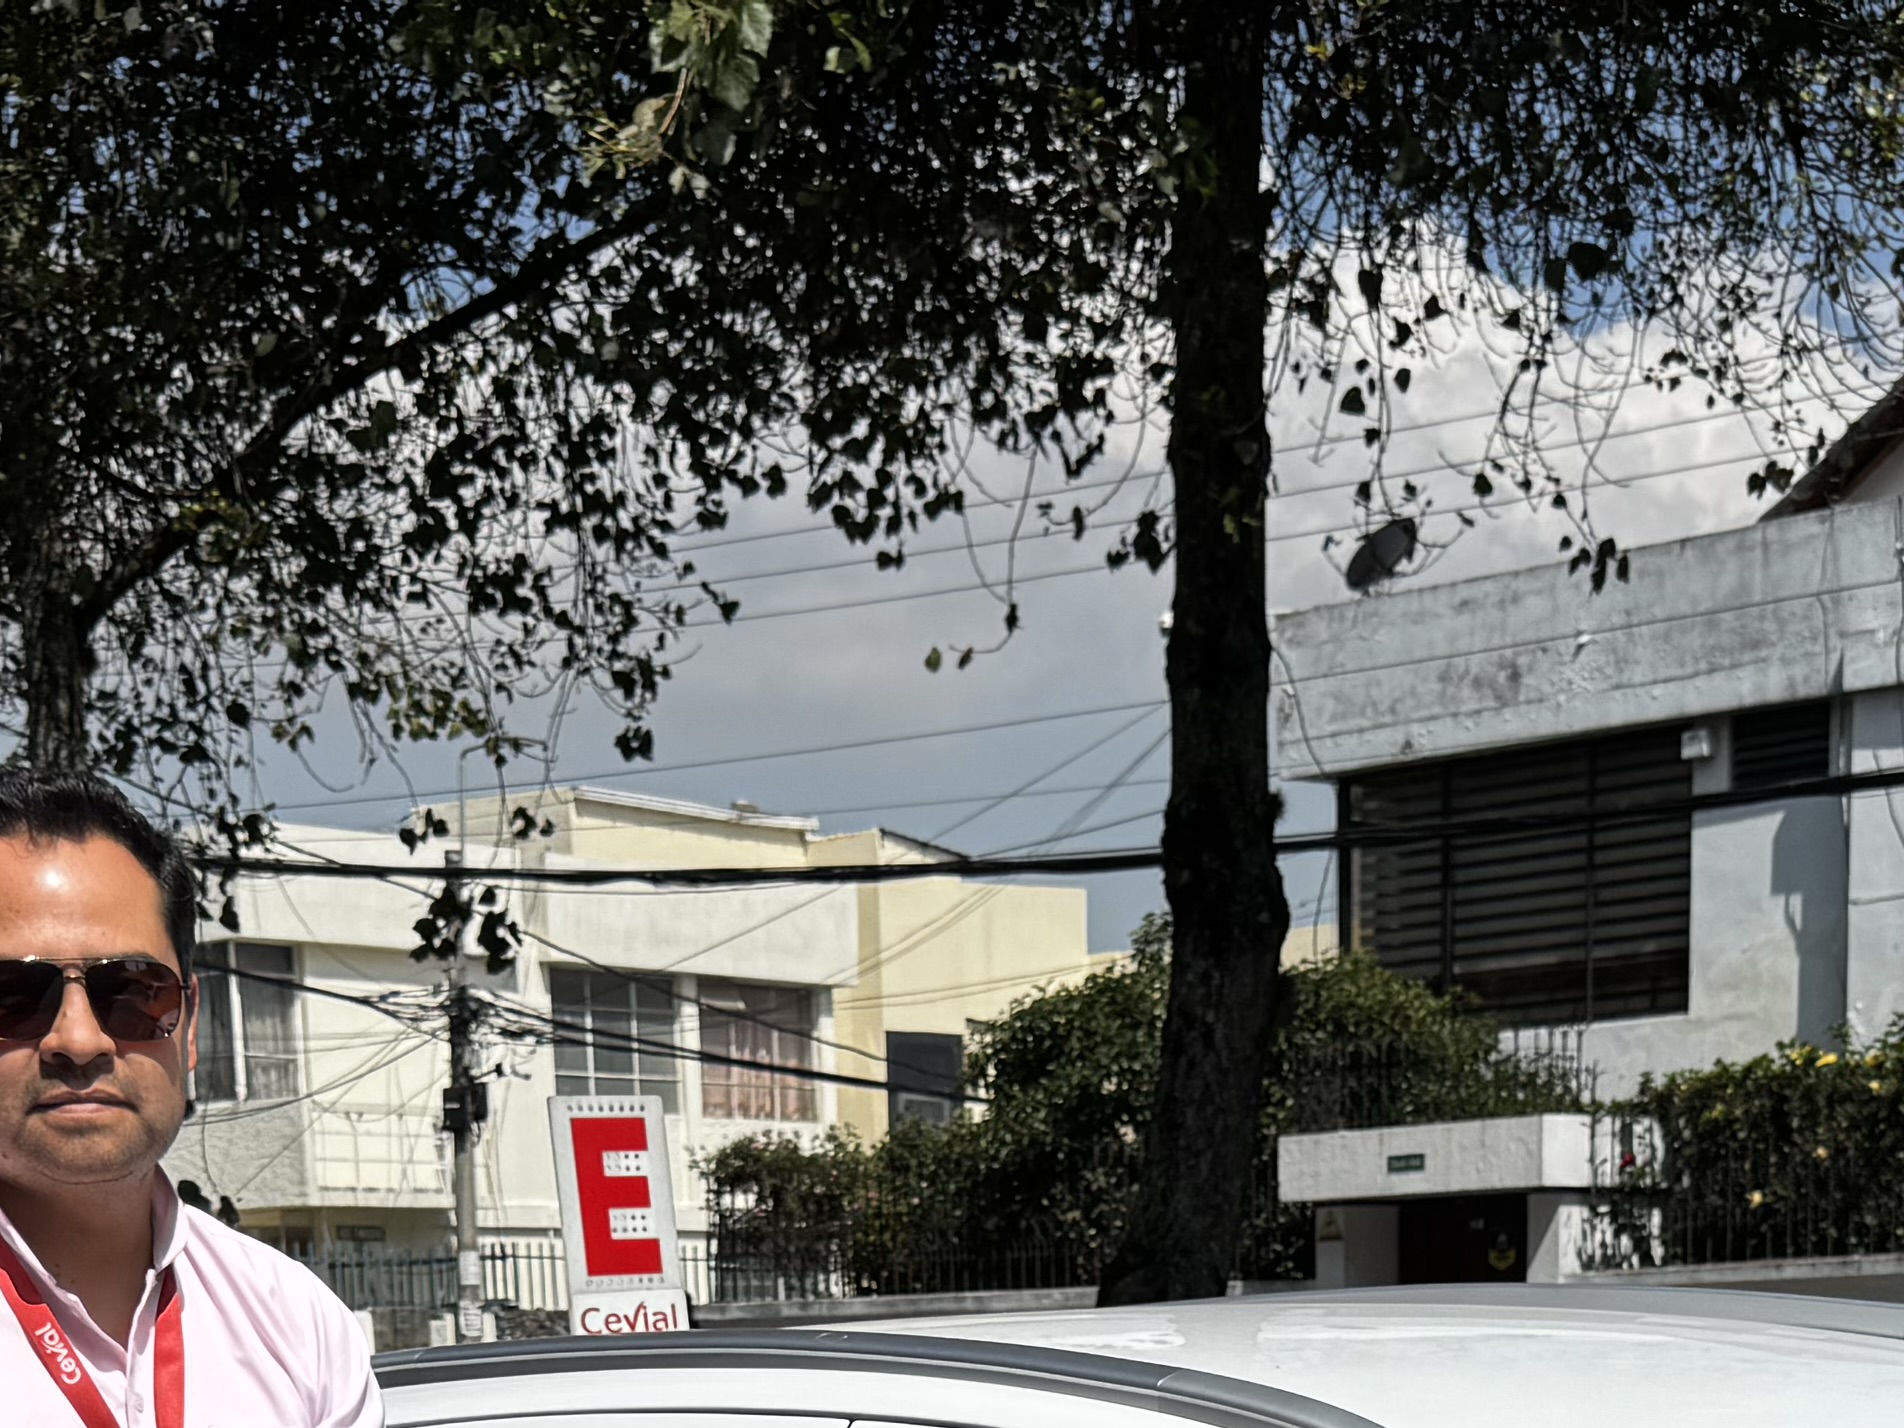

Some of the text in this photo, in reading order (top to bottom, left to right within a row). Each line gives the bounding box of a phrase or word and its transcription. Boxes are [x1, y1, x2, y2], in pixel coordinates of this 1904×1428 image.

[570, 1117, 663, 1277] E
[581, 1301, 678, 1335] Cevial
[35, 1323, 82, 1384] Cevial
